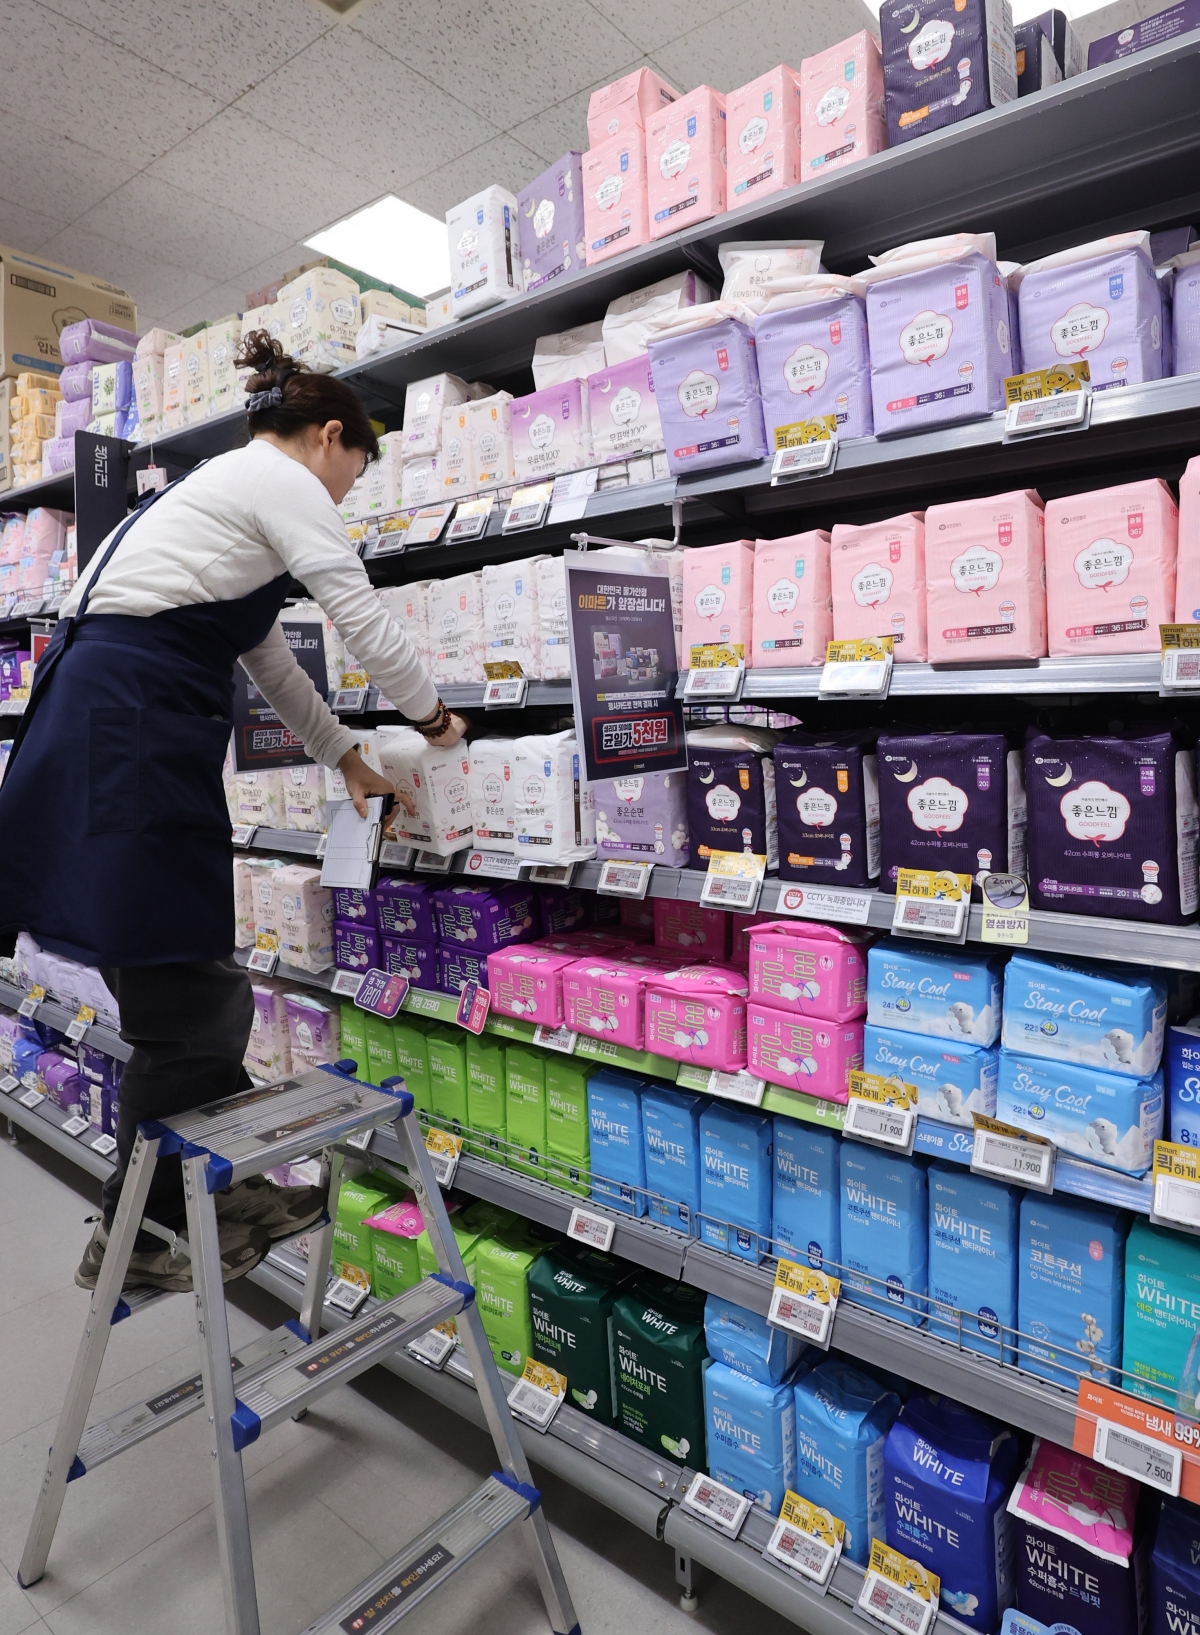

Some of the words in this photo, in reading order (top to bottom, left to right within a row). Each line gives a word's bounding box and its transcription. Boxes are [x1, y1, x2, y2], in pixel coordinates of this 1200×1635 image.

[916, 30, 948, 55] 좋은느낌
[536, 235, 556, 255] 좋은순면
[461, 255, 479, 269] 좋은순면
[1111, 277, 1121, 285] 대형
[908, 326, 943, 347] 좋은느낌
[1060, 320, 1099, 338] 좋은느낌
[1066, 335, 1092, 345] GOODFEEL
[791, 360, 821, 377] 좋은느낌
[685, 385, 713, 400] 좋은느낌
[95, 445, 107, 488] 생리대
[959, 562, 993, 575] 좋은느낌
[1084, 556, 1122, 571] 좋은느낌
[1090, 570, 1117, 578] GOODFEEL
[597, 585, 621, 595] 대한민국
[623, 586, 647, 597] 물가안정
[858, 578, 886, 591] 좋은느낌
[579, 595, 616, 610] 이마트가
[619, 597, 665, 612] 앞장섭니다!
[604, 724, 617, 733] 생리대
[604, 732, 632, 748] 균일가
[633, 720, 666, 745] 5천원
[451, 802, 470, 814] 좋은순면
[486, 806, 504, 815] 좋은순면
[526, 808, 544, 816] 좋은순면
[616, 807, 644, 818] 좋은순면
[804, 803, 831, 811] 좋은느낌
[917, 799, 957, 811] 좋은느낌
[1072, 805, 1117, 818] 좋은느낌
[943, 841, 969, 849] 오버나이트
[1082, 850, 1099, 858] 수퍼롱
[1101, 852, 1132, 860] 오버나이트
[1059, 885, 1083, 893] 오버나이트
[827, 895, 866, 908] 녹화중입니다
[444, 914, 455, 939] zero
[454, 906, 472, 931] feel
[986, 920, 1026, 930] 옆샘방지
[791, 950, 816, 988] feel
[761, 962, 781, 998] zero
[881, 972, 916, 997] Stay
[917, 978, 950, 997] Cool
[359, 985, 381, 1007] zero
[512, 973, 533, 1008] feel
[422, 1000, 440, 1011] ZERO
[576, 998, 592, 1028] zero
[593, 988, 614, 1025] feel
[882, 1001, 891, 1010] 24
[898, 999, 909, 1009] 4h
[1024, 991, 1065, 1018] Stay
[1068, 1000, 1107, 1022] Cool
[657, 1011, 676, 1046] zero
[678, 1001, 704, 1038] feel
[599, 1042, 617, 1057] FEEL
[760, 1035, 781, 1072] zero
[786, 1025, 812, 1063] feel
[875, 1047, 908, 1072] Stay
[909, 1056, 940, 1077] Cool
[1013, 1074, 1051, 1102] Stay
[1055, 1086, 1092, 1110] Cool
[591, 1109, 607, 1119] 화이트
[816, 1101, 827, 1118] 샘
[1013, 1105, 1022, 1113] 22
[592, 1118, 629, 1138] WHITE
[1181, 1129, 1190, 1144] 8
[918, 1133, 943, 1146] 스테이쿨
[1157, 1145, 1177, 1155] emart
[705, 1155, 749, 1181] WHITE
[777, 1157, 818, 1185] WHITE
[846, 1187, 897, 1216] WHITE
[847, 1203, 870, 1217] 코튼쿠션
[870, 1212, 901, 1229] 팬티라이너
[935, 1212, 991, 1246] WHITE
[935, 1229, 961, 1245] 코튼쿠션
[961, 1237, 996, 1258] 팬티라이너
[1030, 1249, 1082, 1278] 코튼쿠션
[554, 1274, 586, 1293] WHITE
[1030, 1264, 1052, 1276] COTTON
[1054, 1271, 1082, 1286] CUSHION
[1137, 1273, 1166, 1290] 화이트
[481, 1291, 513, 1313] WHITE
[533, 1307, 550, 1320] 화이트
[1136, 1302, 1153, 1314] 데오
[1154, 1309, 1197, 1331] 팬티라이너
[1136, 1311, 1154, 1324] 15cm
[1155, 1319, 1167, 1329] 일반
[533, 1316, 576, 1348] WHITE
[535, 1332, 561, 1352] 네이처포레
[619, 1345, 638, 1360] 화이트
[619, 1354, 667, 1393] WHITE
[620, 1372, 651, 1396] 네이처포레
[713, 1406, 733, 1420] 화이트
[713, 1418, 761, 1449] WHITE
[1146, 1414, 1171, 1436] 냄새
[714, 1432, 740, 1450] 수퍼흡수
[916, 1438, 939, 1457] 화이트
[912, 1446, 965, 1486] WHITE
[894, 1492, 922, 1511] 화이트
[1041, 1471, 1079, 1516] zero
[894, 1500, 959, 1548] WHITE
[896, 1520, 929, 1541] 수퍼흡수
[1025, 1534, 1058, 1555] 화이트
[1026, 1544, 1099, 1593] WHITE
[1027, 1566, 1068, 1592] 수퍼흡수
[1069, 1585, 1100, 1608] 드림핏
